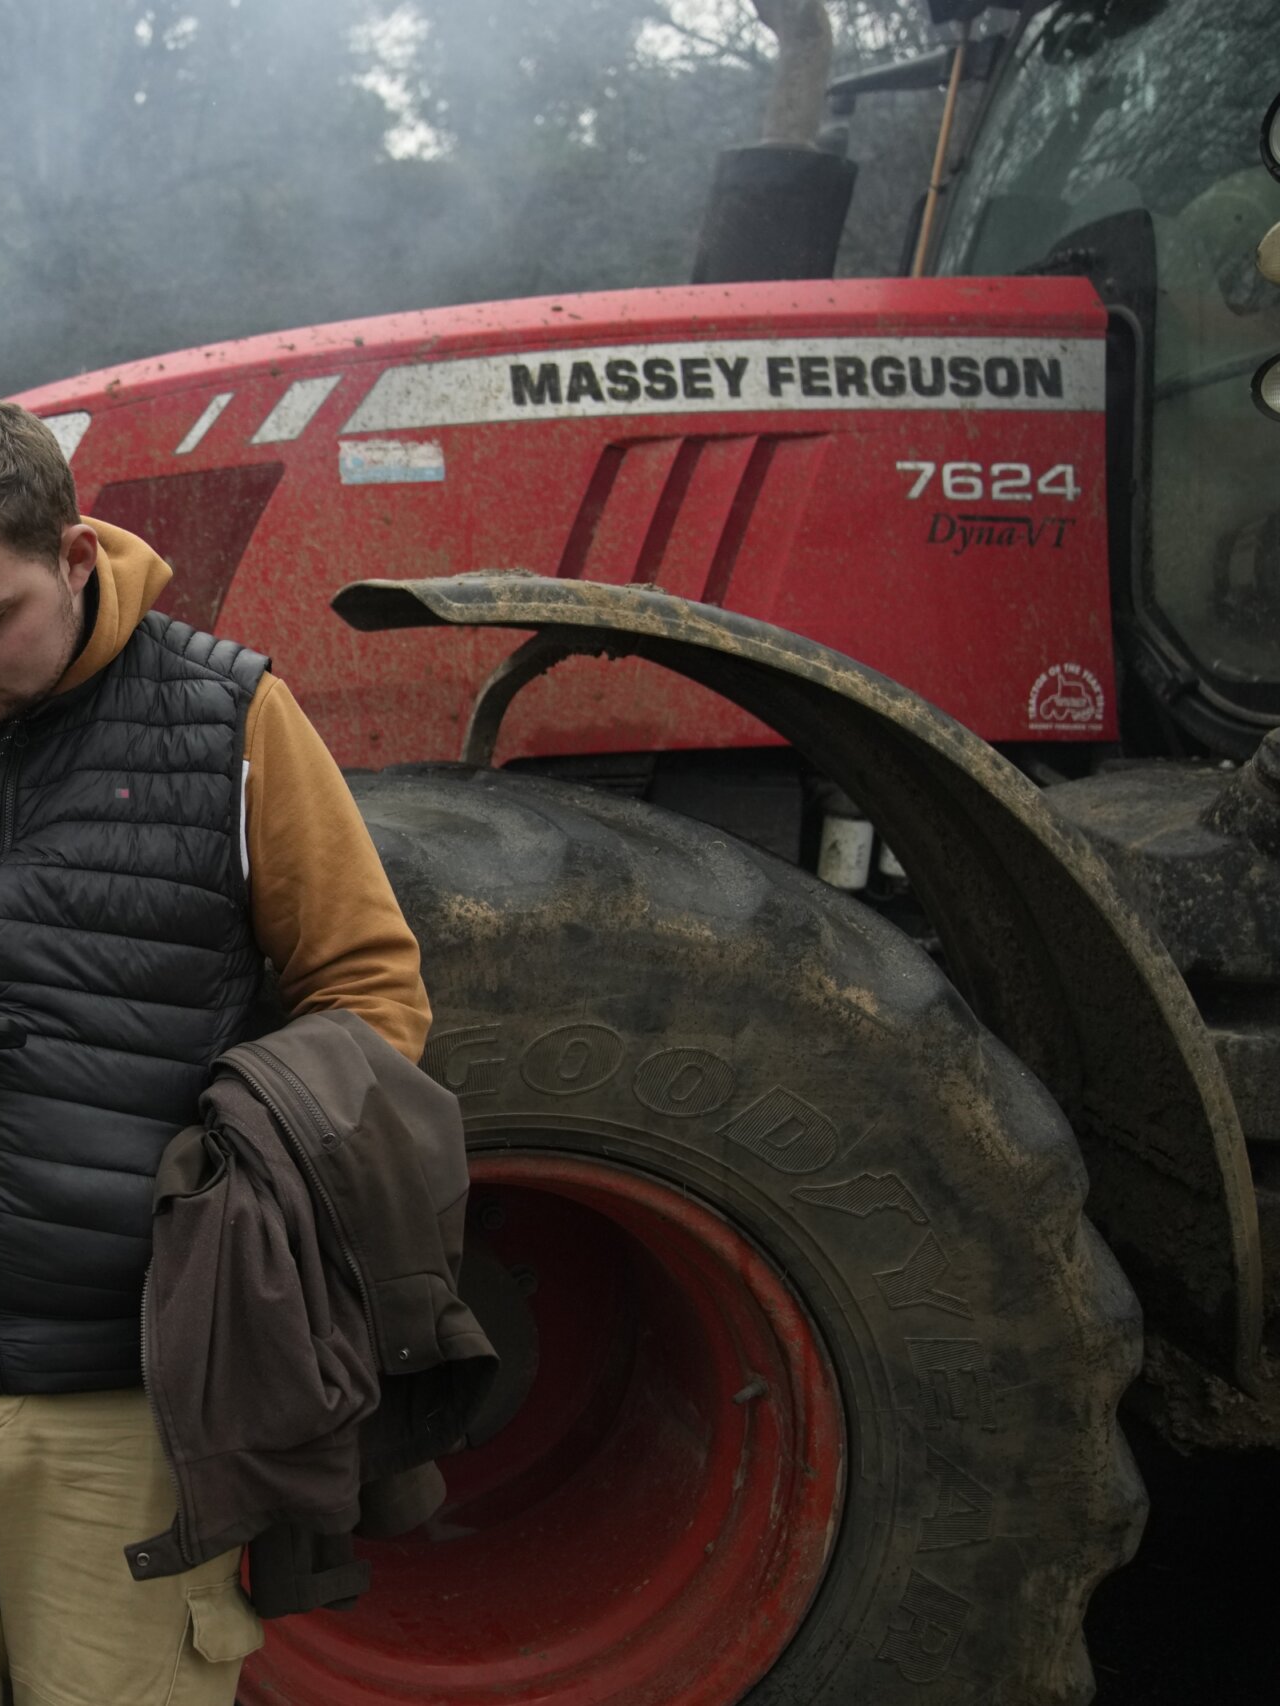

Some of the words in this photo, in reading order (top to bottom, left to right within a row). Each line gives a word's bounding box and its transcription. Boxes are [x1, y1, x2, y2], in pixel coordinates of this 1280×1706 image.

[510, 357, 748, 406] MASSEY
[766, 355, 1063, 398] FERGUSON
[896, 460, 1081, 502] 7624
[1064, 662, 1081, 675] THE
